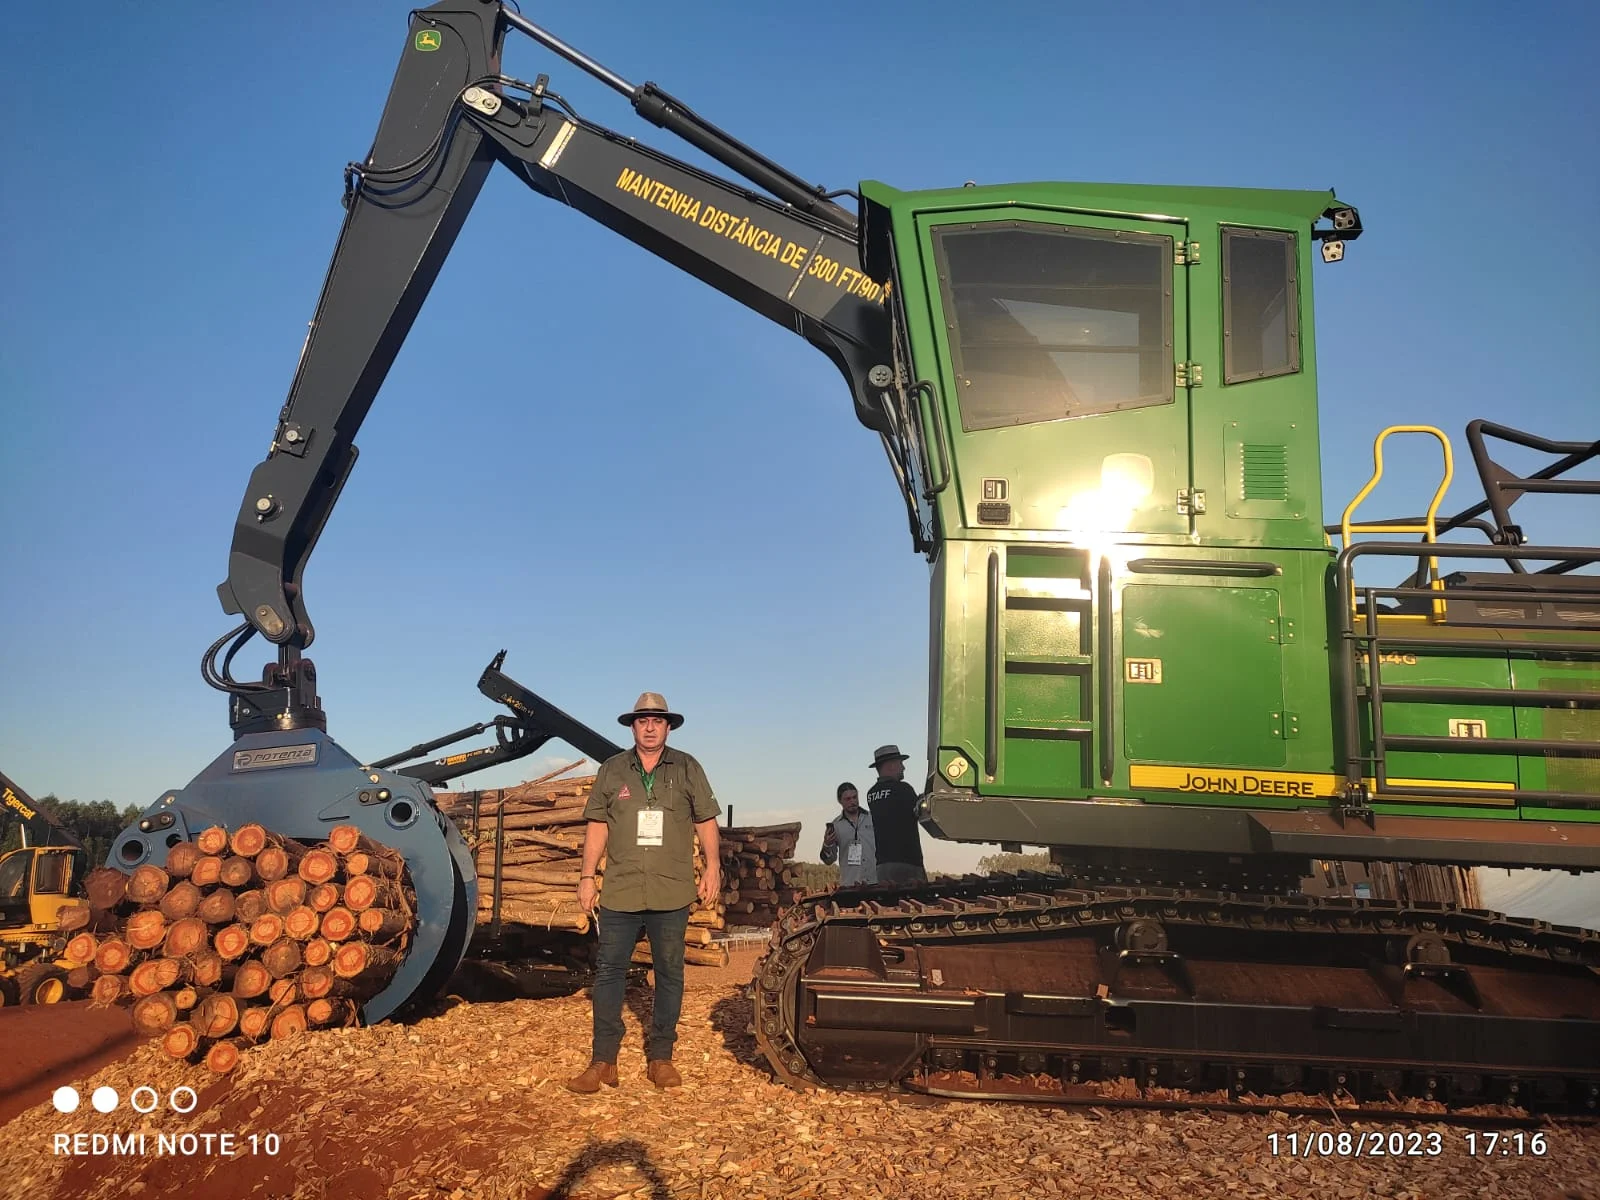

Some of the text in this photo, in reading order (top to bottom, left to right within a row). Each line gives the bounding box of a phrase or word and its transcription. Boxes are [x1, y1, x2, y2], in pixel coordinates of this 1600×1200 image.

[615, 167, 702, 223] MANTENHA
[698, 205, 782, 259] DISTÂNCIA
[780, 242, 808, 270] DE
[808, 254, 839, 283] 300
[867, 789, 891, 803] STAFF
[1180, 773, 1315, 796] JOHN DEERE
[2, 787, 36, 820] Tigercat
